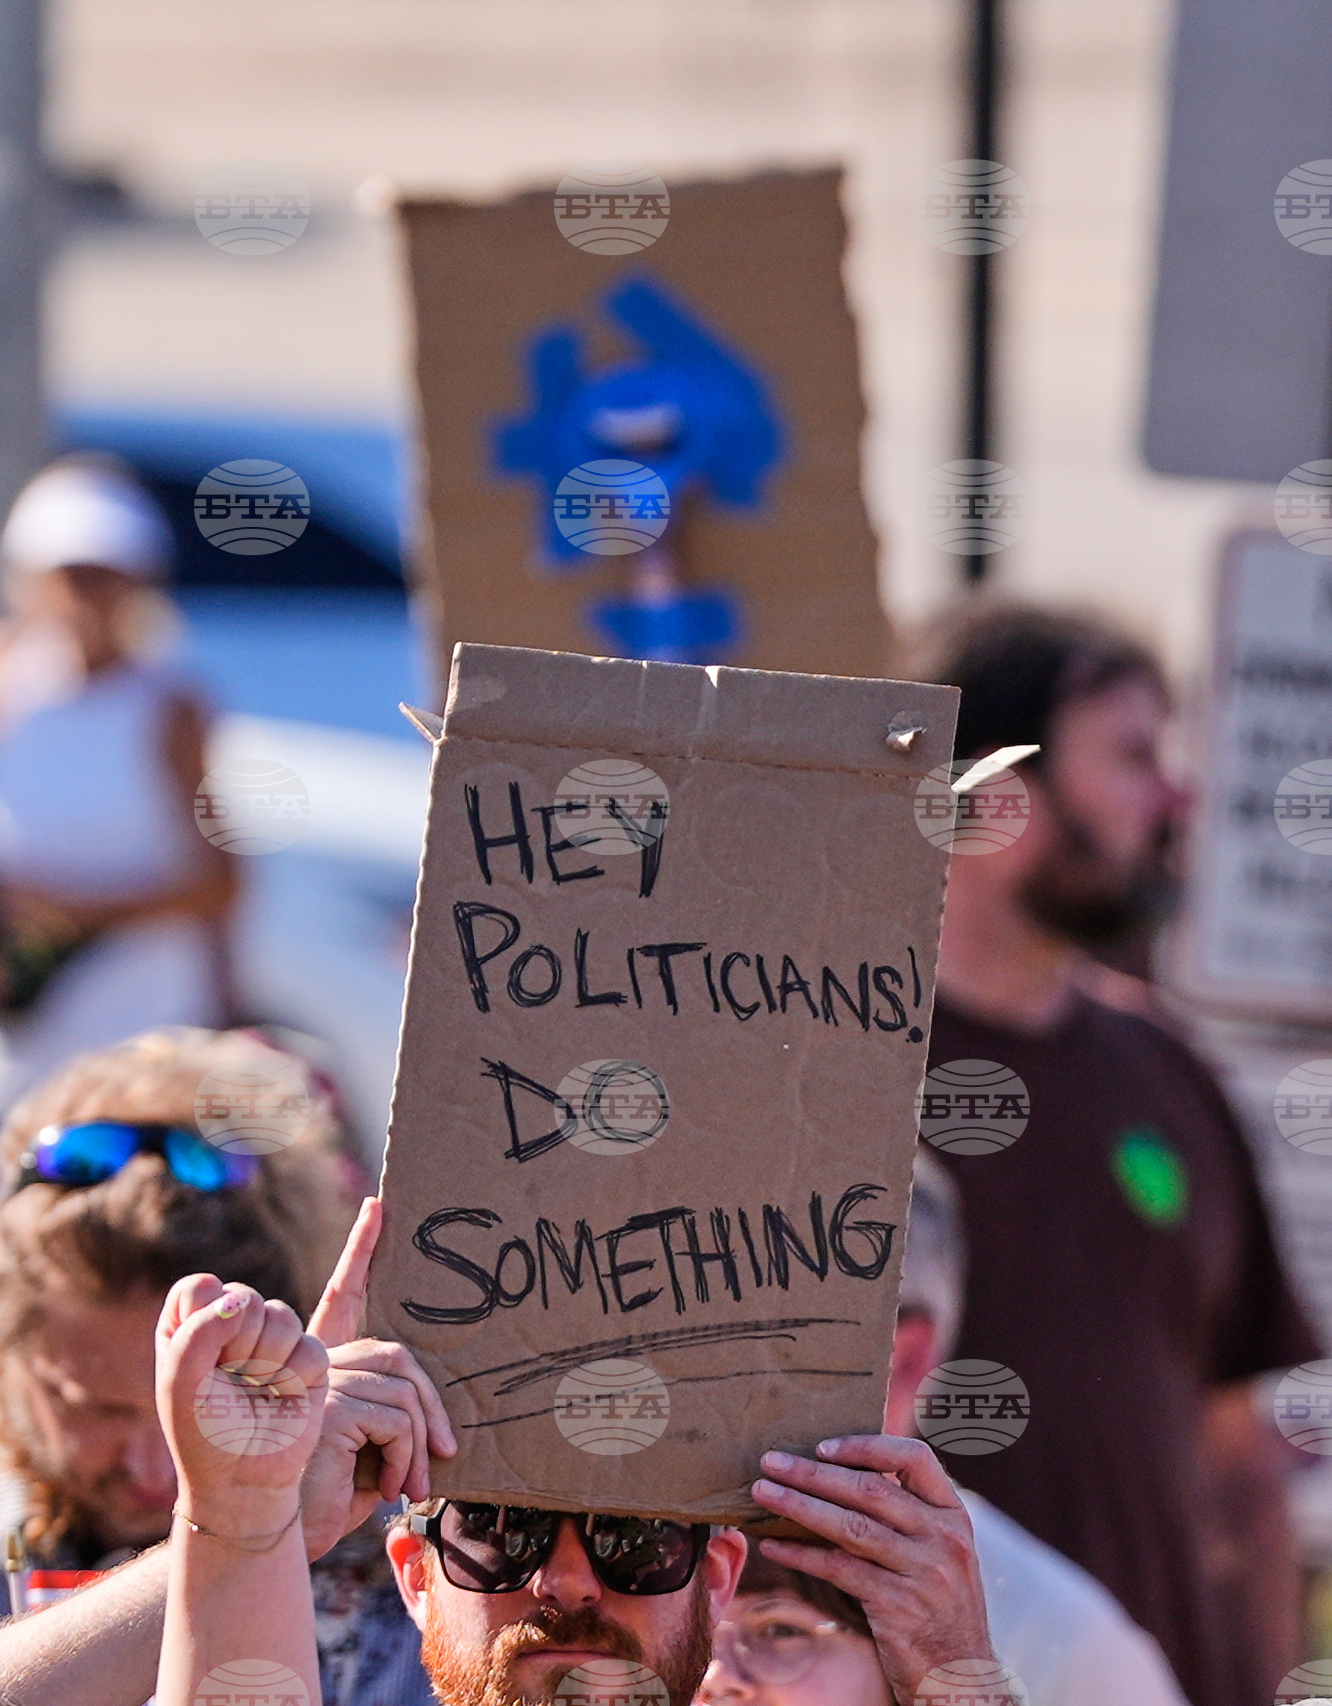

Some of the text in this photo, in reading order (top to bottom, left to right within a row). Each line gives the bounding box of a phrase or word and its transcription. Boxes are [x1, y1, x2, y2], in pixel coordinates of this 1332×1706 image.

[464, 781, 670, 898] HEY
[453, 901, 924, 1043] POLITICIANS!
[480, 1059, 671, 1163] DO
[402, 1183, 899, 1325] SOMETHING
